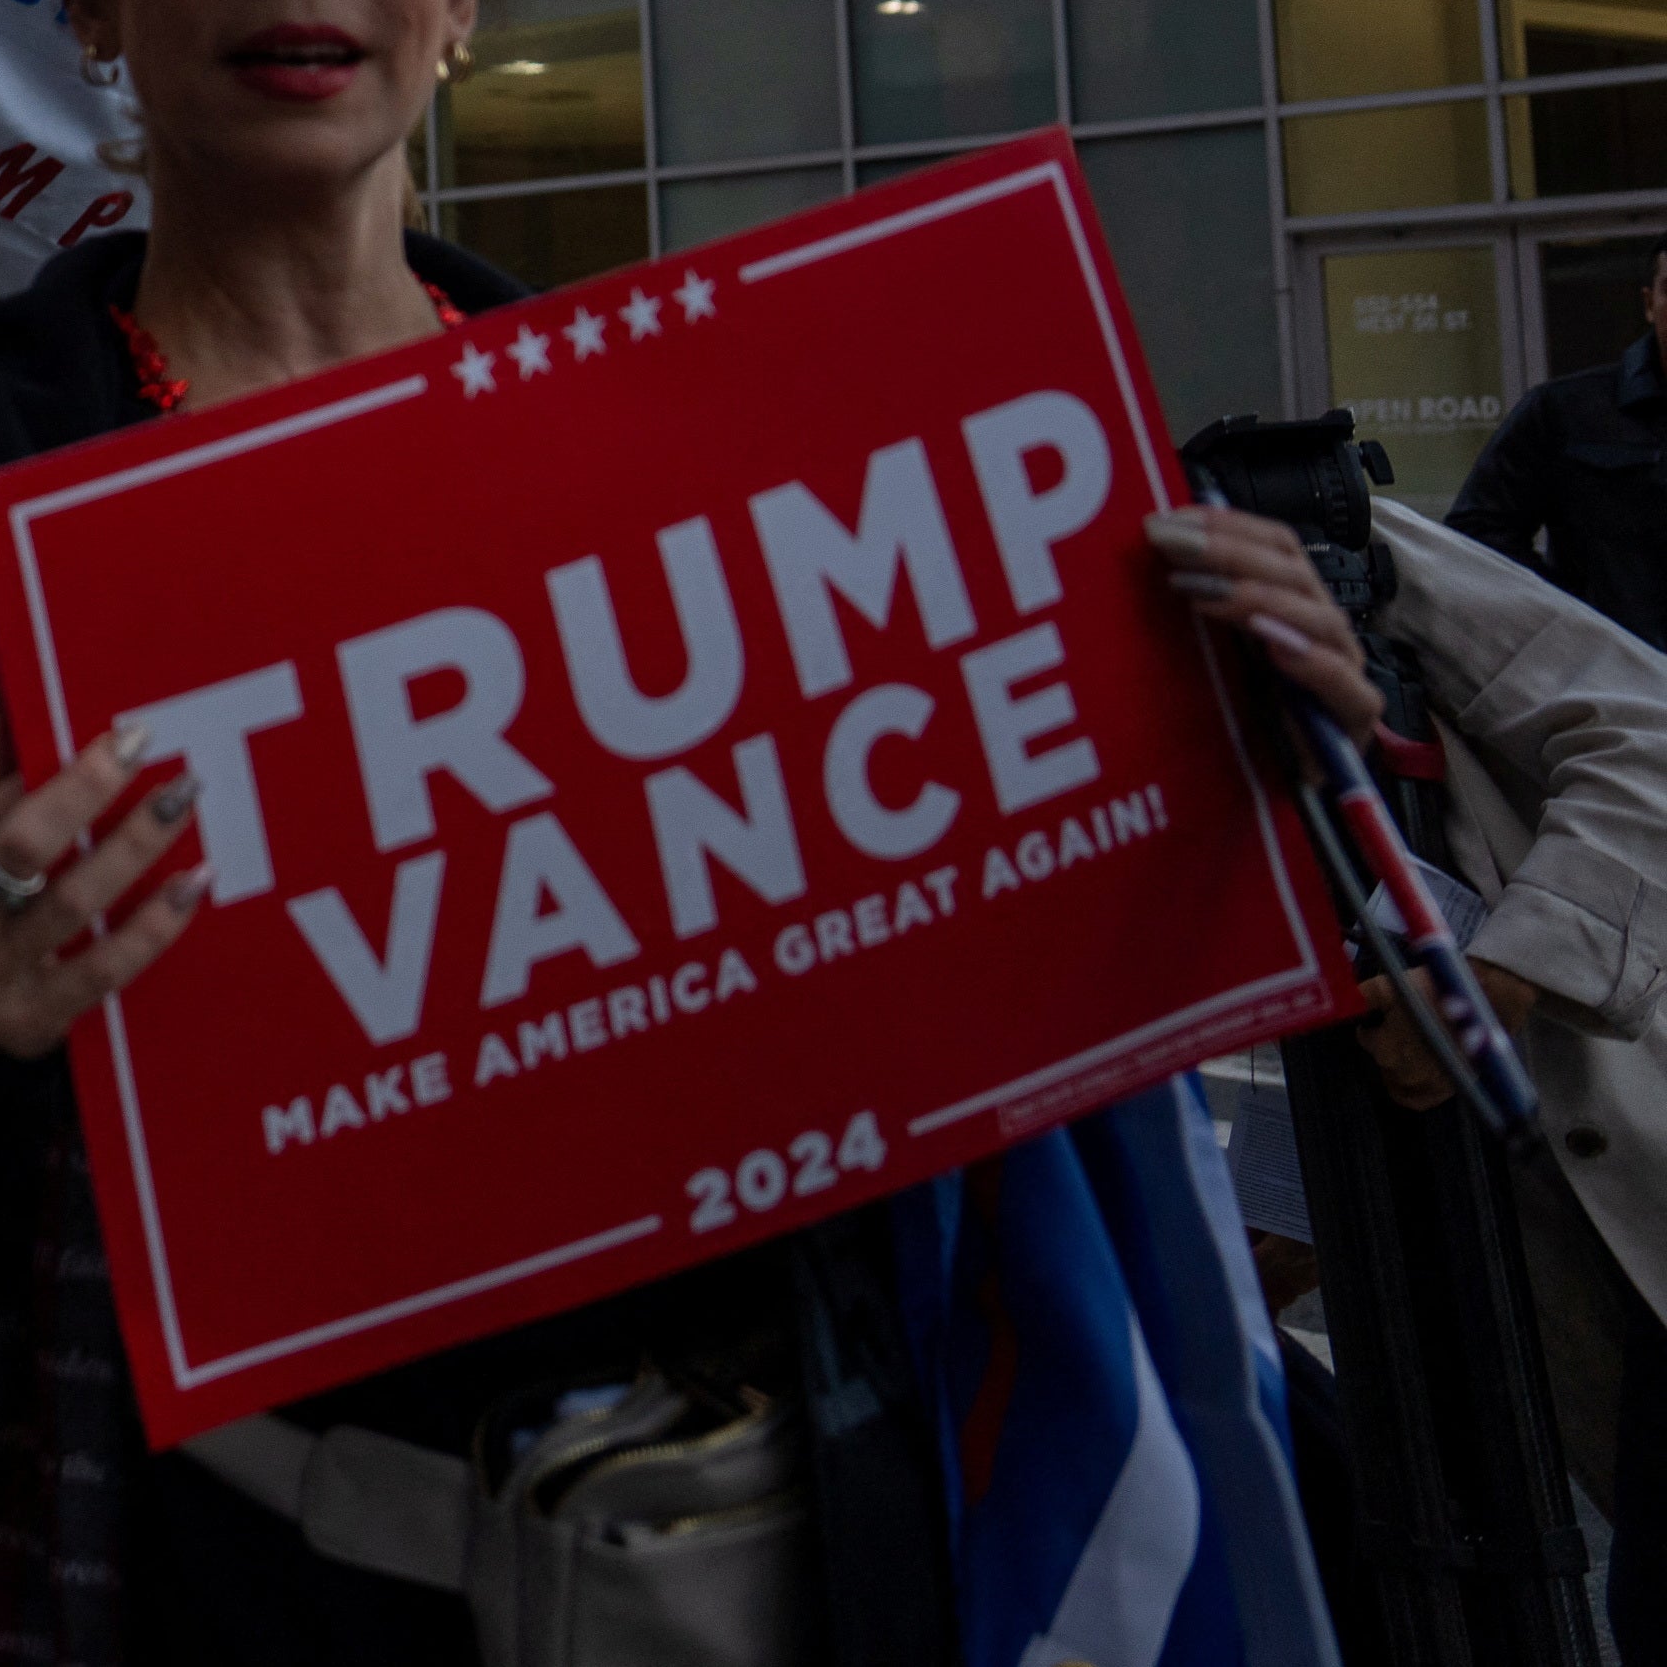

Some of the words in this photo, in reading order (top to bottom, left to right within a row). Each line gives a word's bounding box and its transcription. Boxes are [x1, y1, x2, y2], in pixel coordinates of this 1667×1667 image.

[1419, 394, 1501, 421] ROAD
[111, 388, 1115, 910] TRUMP
[286, 621, 1104, 1047] VANCE
[260, 1049, 453, 1155] MAKE
[474, 948, 759, 1088] AMERICA
[771, 865, 963, 981] GREAT
[978, 783, 1173, 902] AGAIN!
[682, 1111, 890, 1235] 2024
